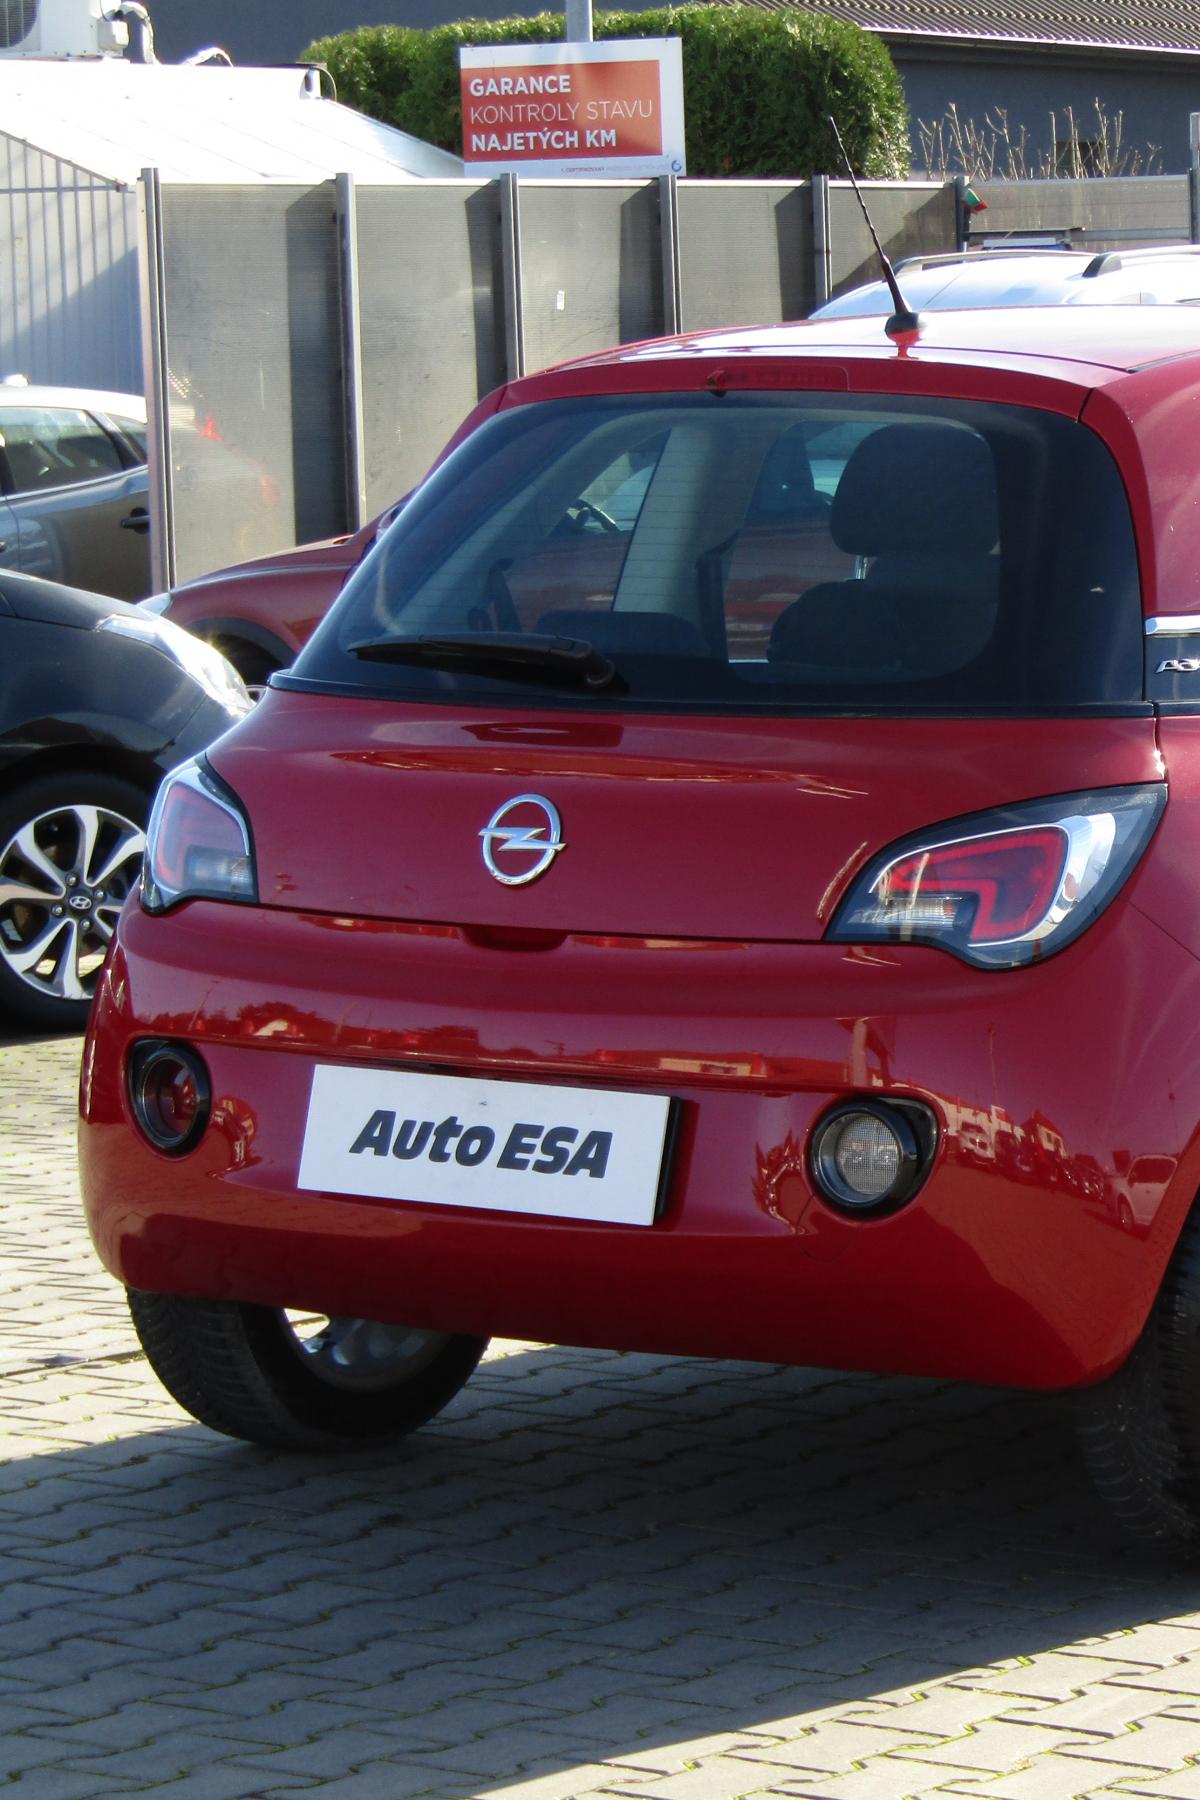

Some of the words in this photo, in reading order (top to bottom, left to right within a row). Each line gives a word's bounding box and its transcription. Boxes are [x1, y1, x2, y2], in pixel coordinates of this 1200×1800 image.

[469, 75, 571, 97] GARANCE
[470, 102, 581, 125] KONTROLY
[586, 99, 653, 120] STAVU
[471, 127, 579, 152] NAJETÝCH
[586, 129, 616, 148] KM
[348, 1109, 496, 1167] Auto
[496, 1122, 614, 1179] ESA
